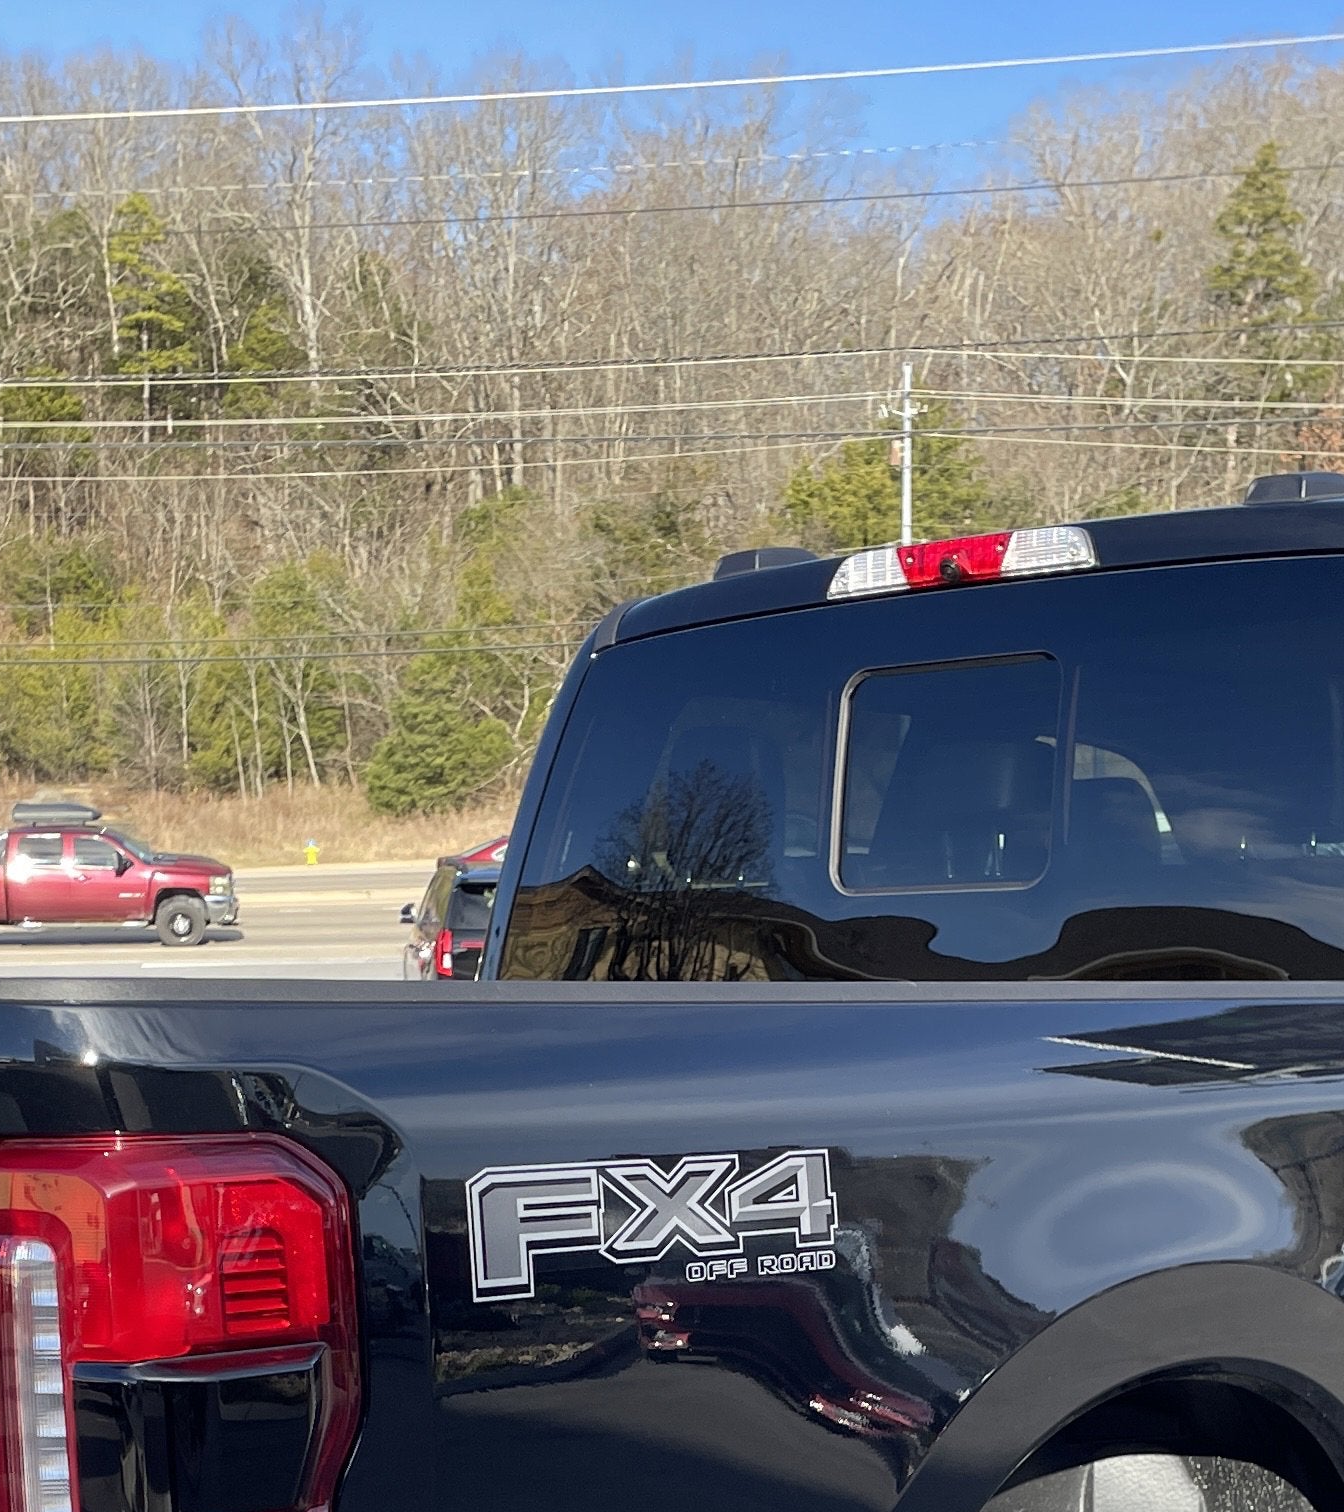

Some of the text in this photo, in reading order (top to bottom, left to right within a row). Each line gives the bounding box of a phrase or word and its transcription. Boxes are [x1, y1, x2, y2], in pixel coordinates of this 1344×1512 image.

[466, 1149, 838, 1302] FX4
[685, 1249, 836, 1282] OFF ROAD
